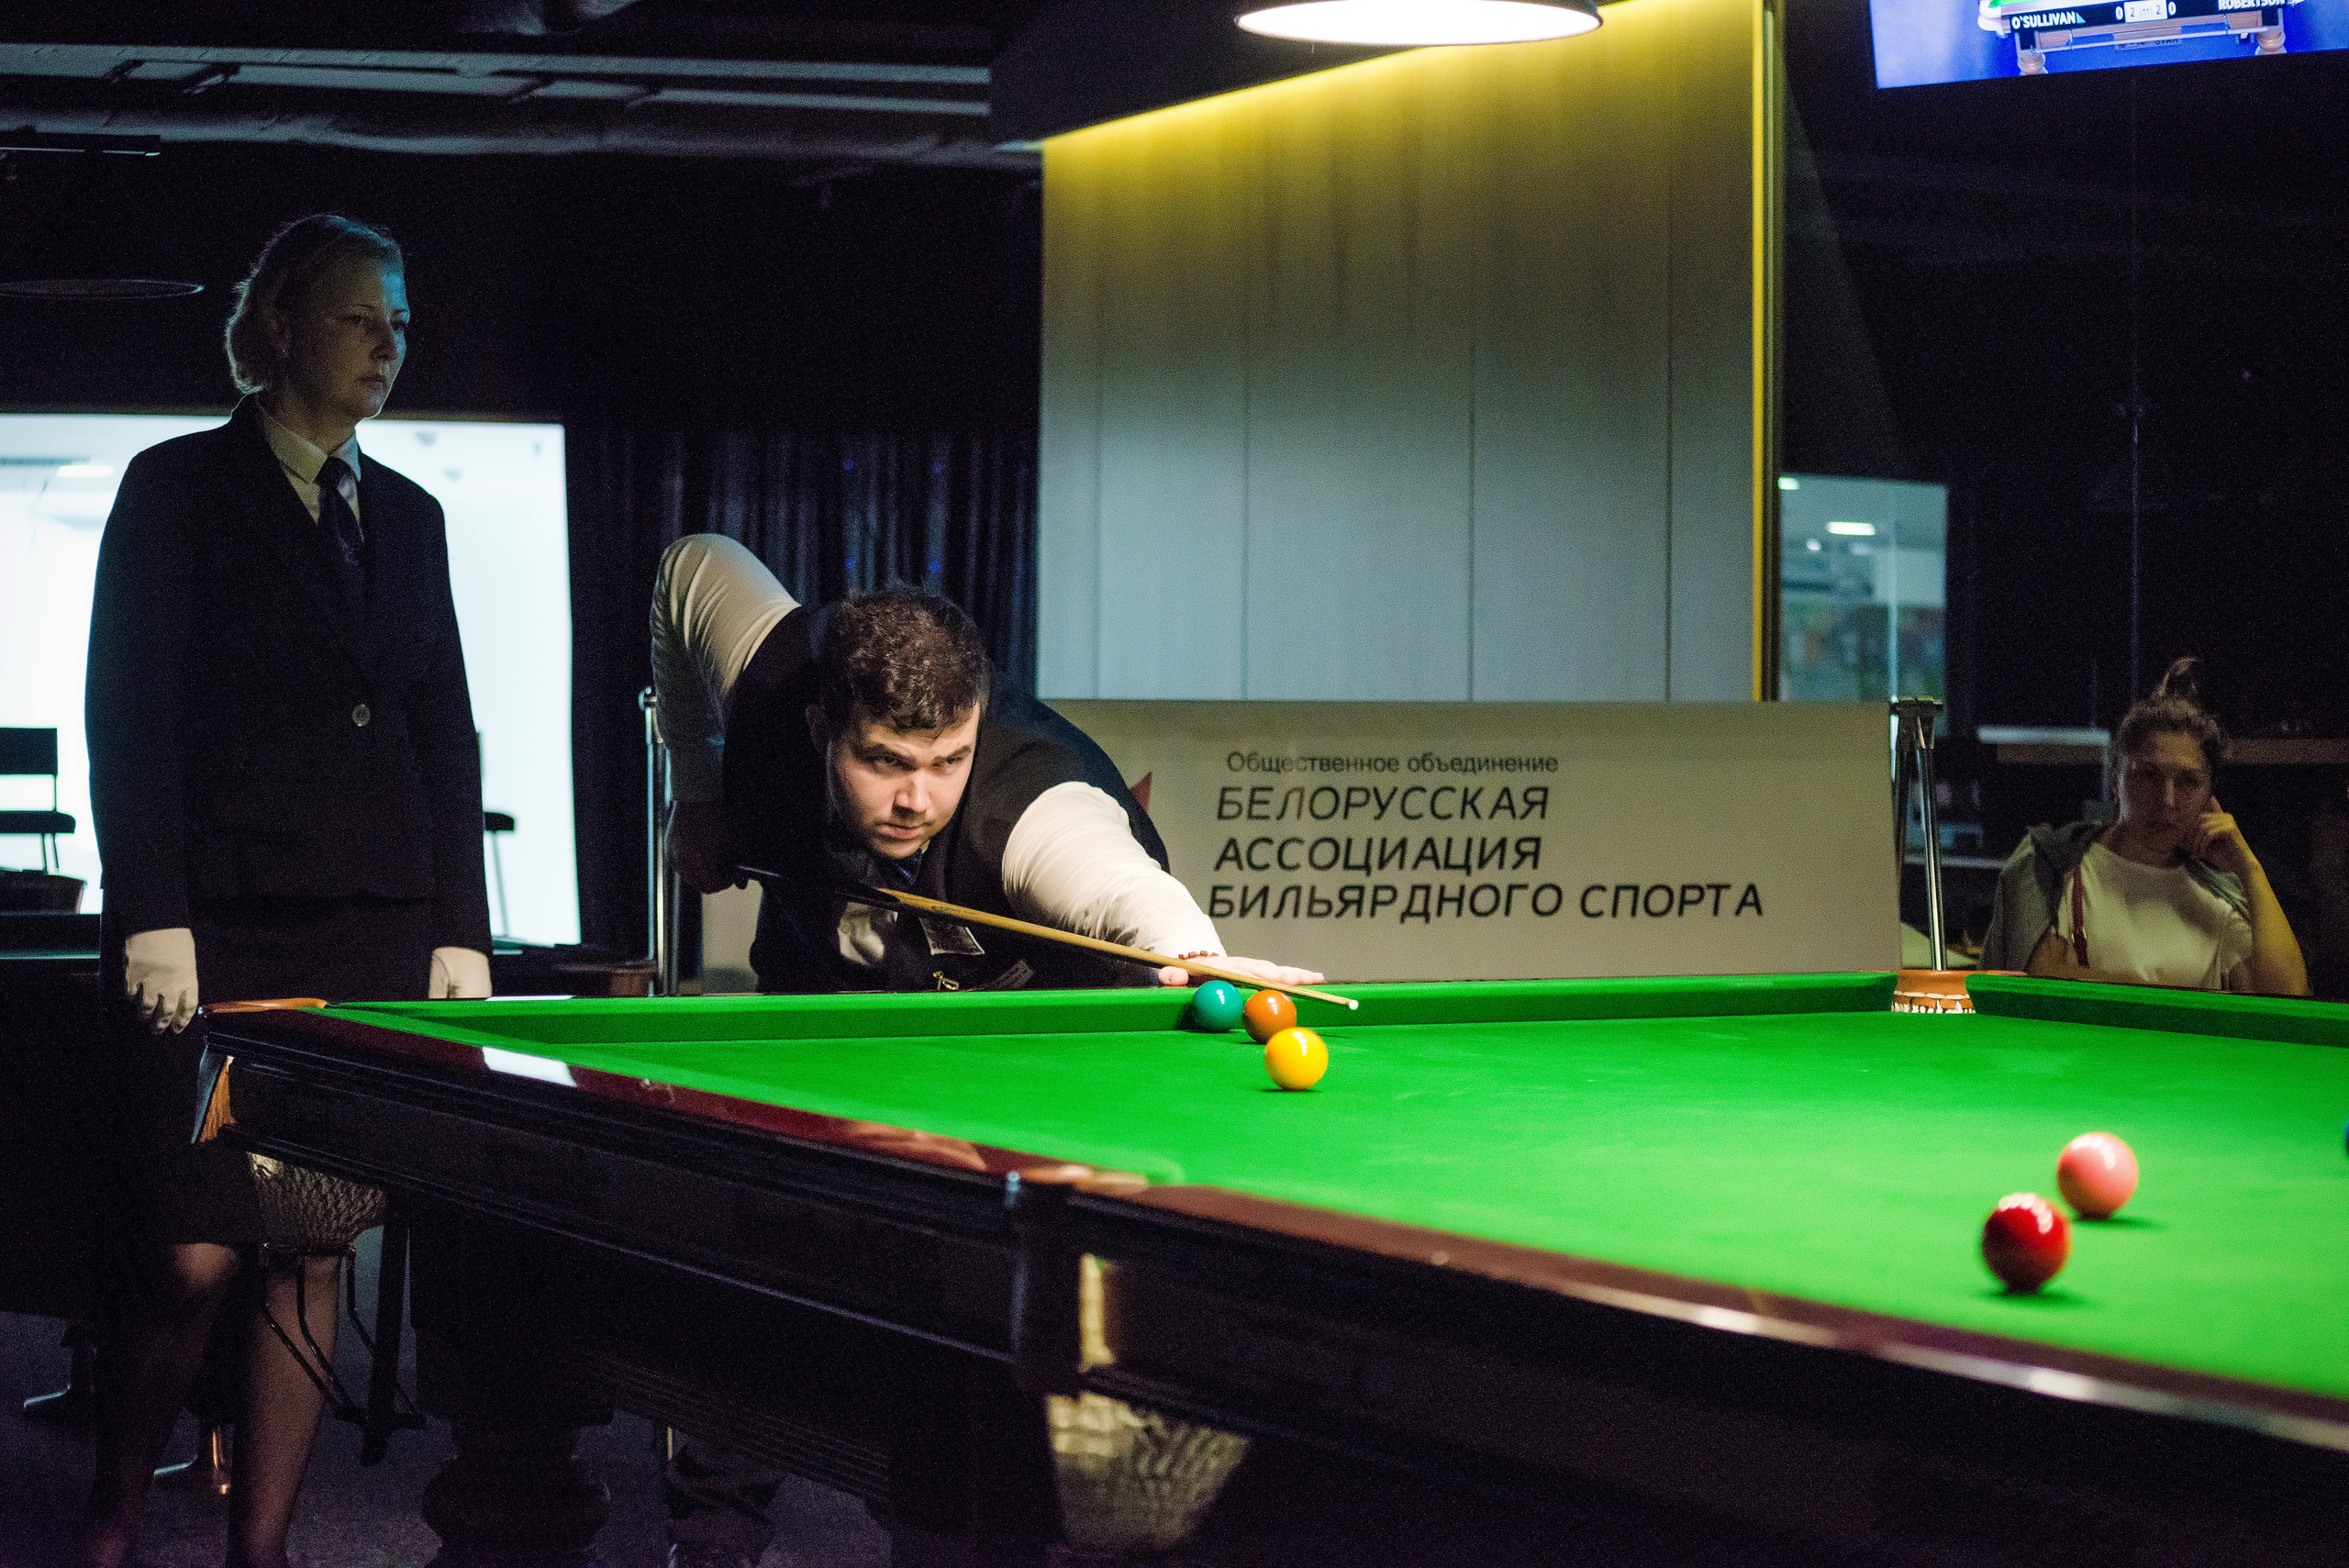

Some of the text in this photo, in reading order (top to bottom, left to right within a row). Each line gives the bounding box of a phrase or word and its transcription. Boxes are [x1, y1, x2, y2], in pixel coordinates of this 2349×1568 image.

[2011, 11, 2076, 29] O'SULLIVAN
[2115, 6, 2123, 20] 0
[2130, 7, 2135, 17] 2
[2140, 7, 2153, 17] (11)
[2156, 5, 2162, 15] 2
[2167, 1, 2176, 16] 0
[1227, 751, 1559, 775] Общественное объединение
[1217, 785, 1550, 821] БЕЛОРУССКАЯ
[1214, 836, 1542, 876] АССОЦИАЦИЯ
[1208, 883, 1764, 924] БИЛЬЯРДНОГО СПОРТА
